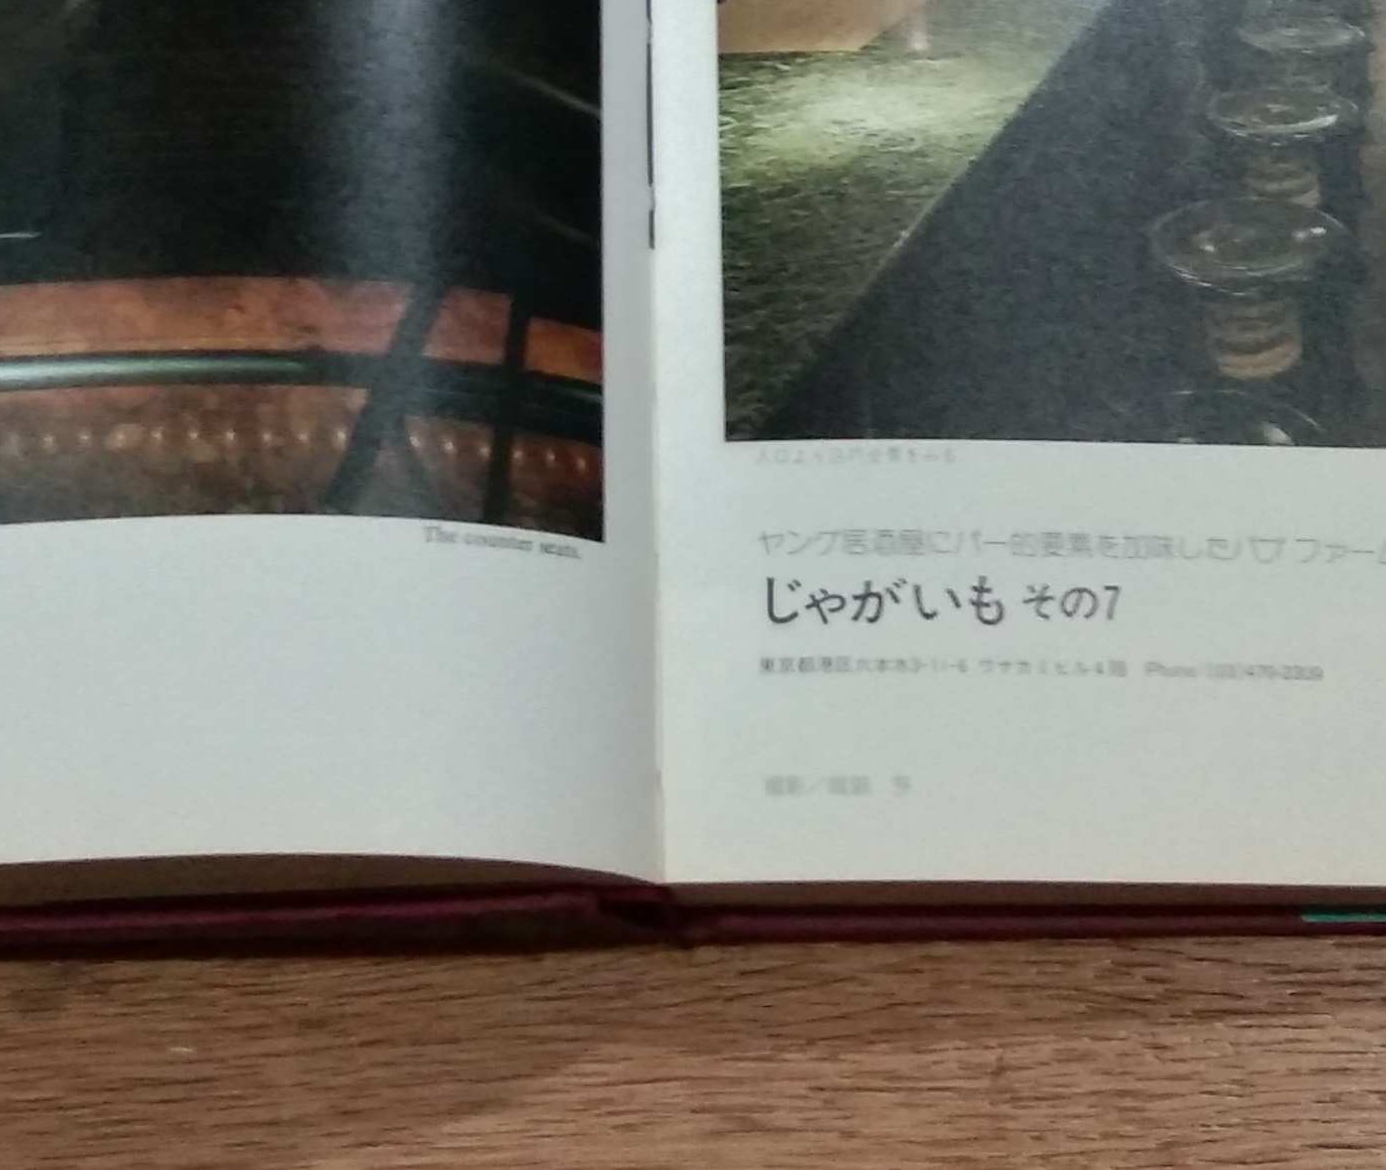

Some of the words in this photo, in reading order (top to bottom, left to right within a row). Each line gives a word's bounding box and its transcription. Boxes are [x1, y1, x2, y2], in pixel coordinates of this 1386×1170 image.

[766, 575, 1005, 626] じゃがいも
[1021, 583, 1121, 621] その7
